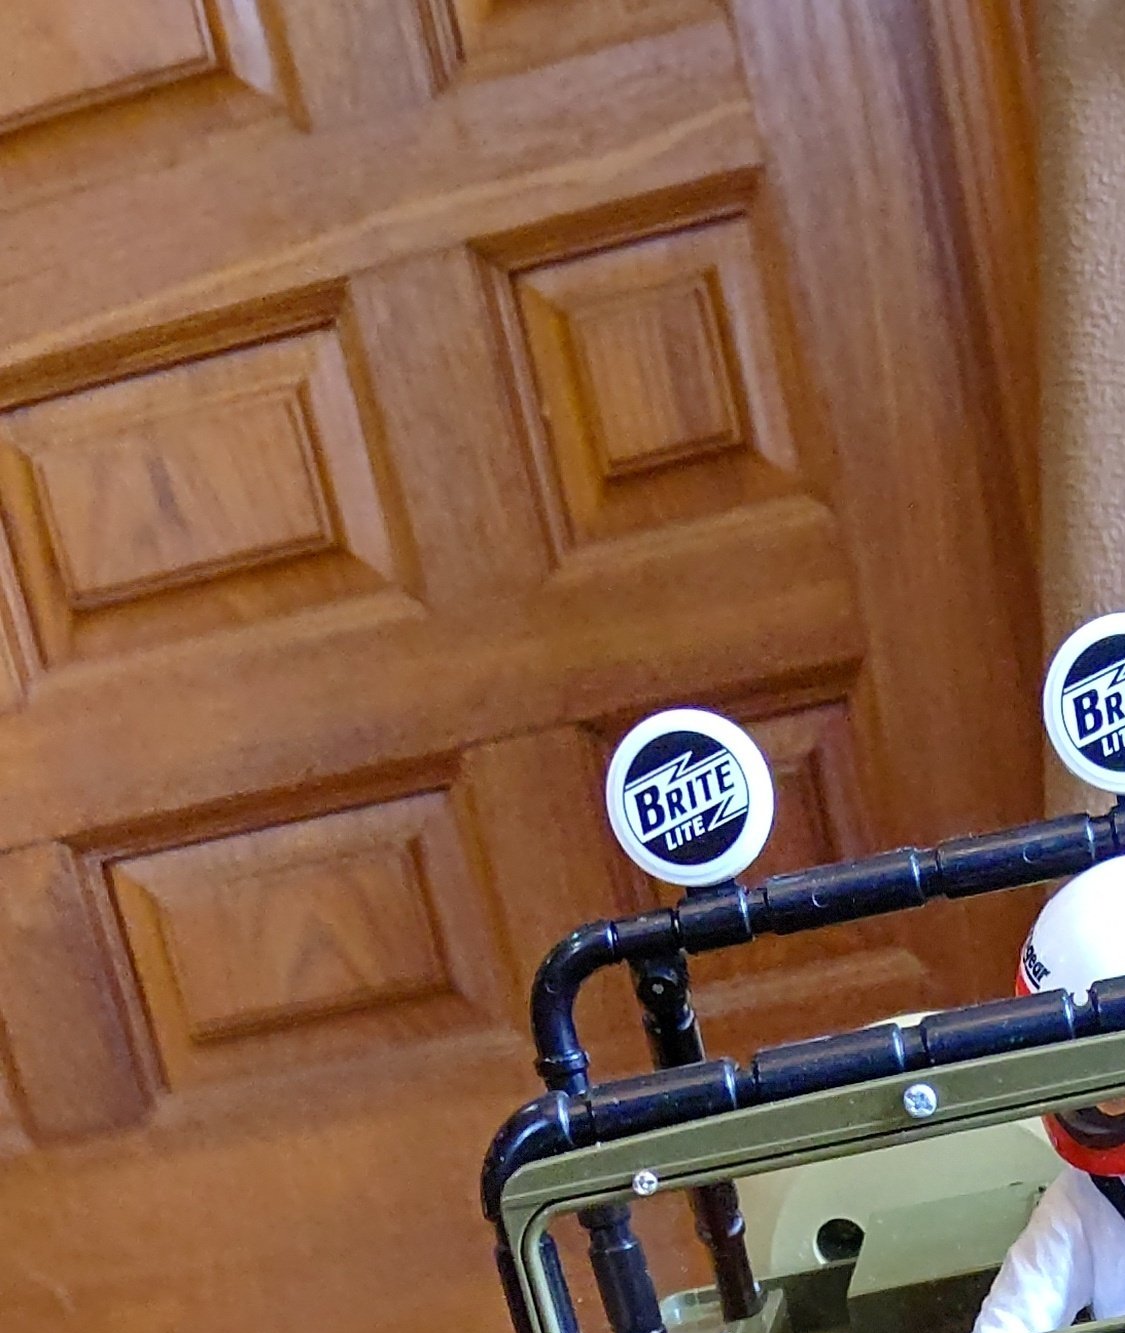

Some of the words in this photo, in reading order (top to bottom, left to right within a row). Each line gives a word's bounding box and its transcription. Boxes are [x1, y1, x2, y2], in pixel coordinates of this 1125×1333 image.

[633, 760, 735, 836] BRITE
[664, 815, 706, 852] LITE
[1023, 942, 1051, 982] gear
